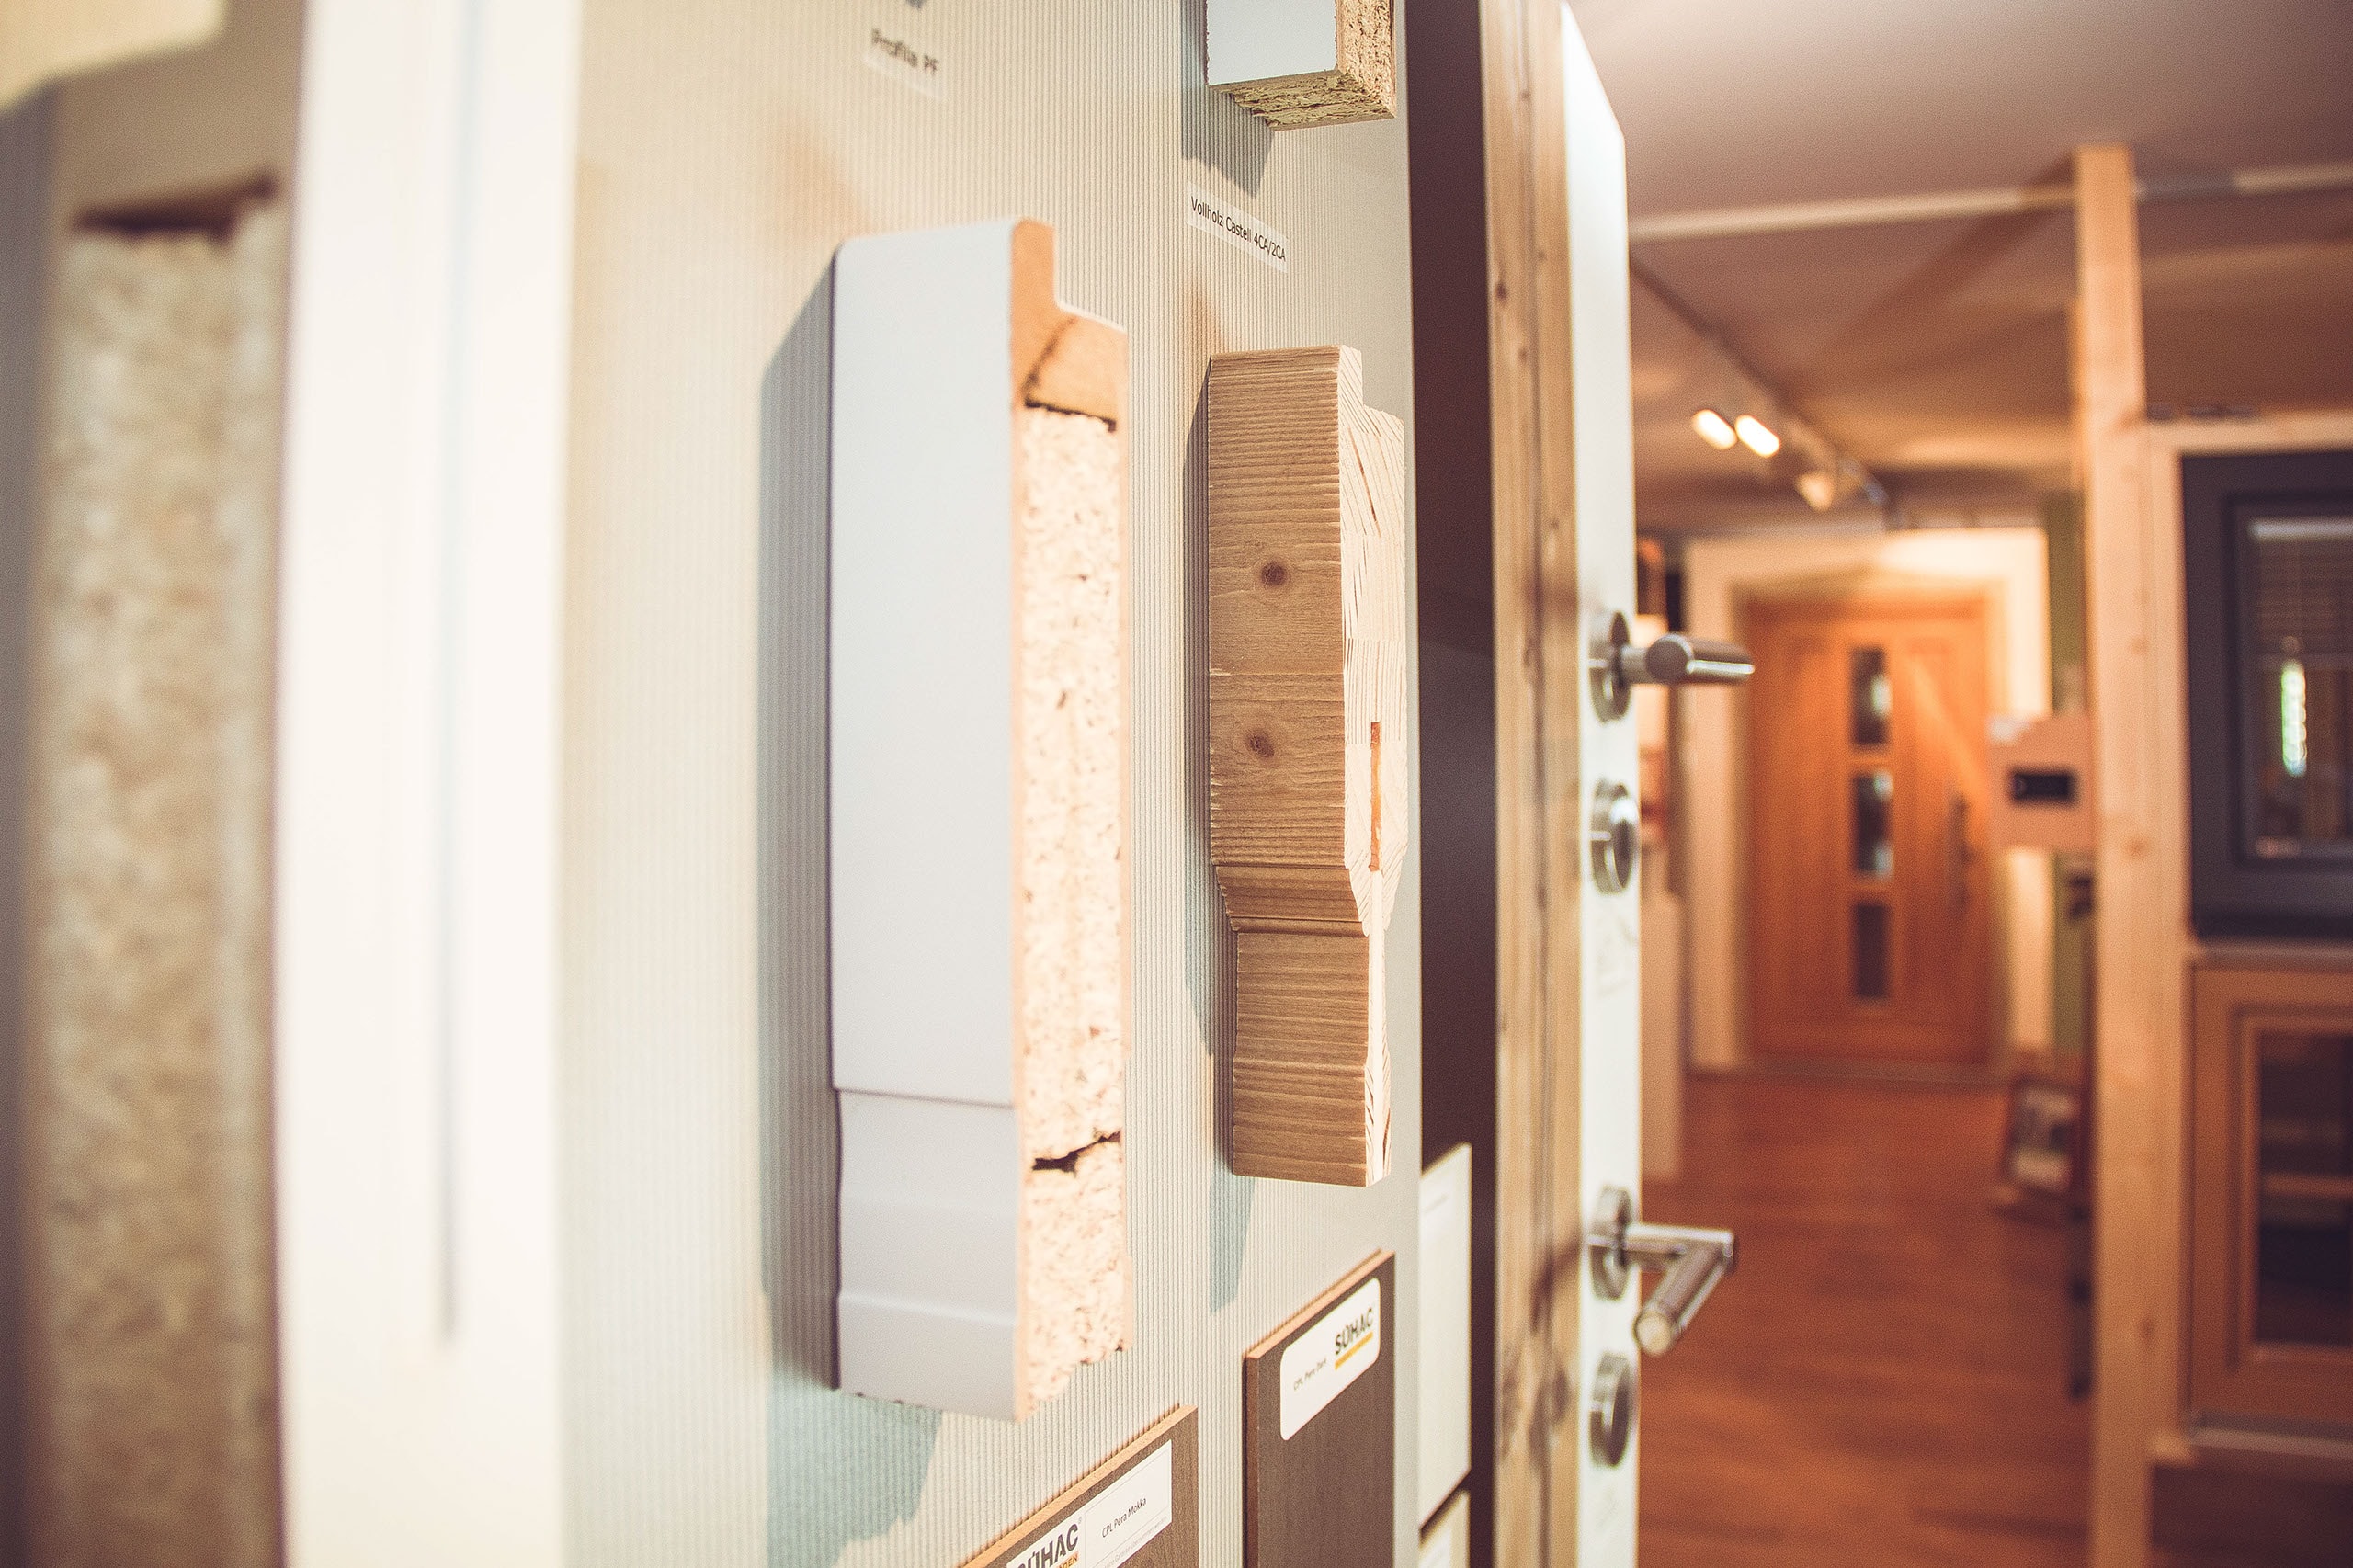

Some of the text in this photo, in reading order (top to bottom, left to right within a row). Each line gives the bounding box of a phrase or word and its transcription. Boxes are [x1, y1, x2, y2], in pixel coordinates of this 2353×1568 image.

[1190, 195, 1287, 262] Vollholz Castell 4CA/2CA
[1102, 1497, 1147, 1538] CPL Pera Mokka
[1017, 1523, 1079, 1568] ÜHAC
